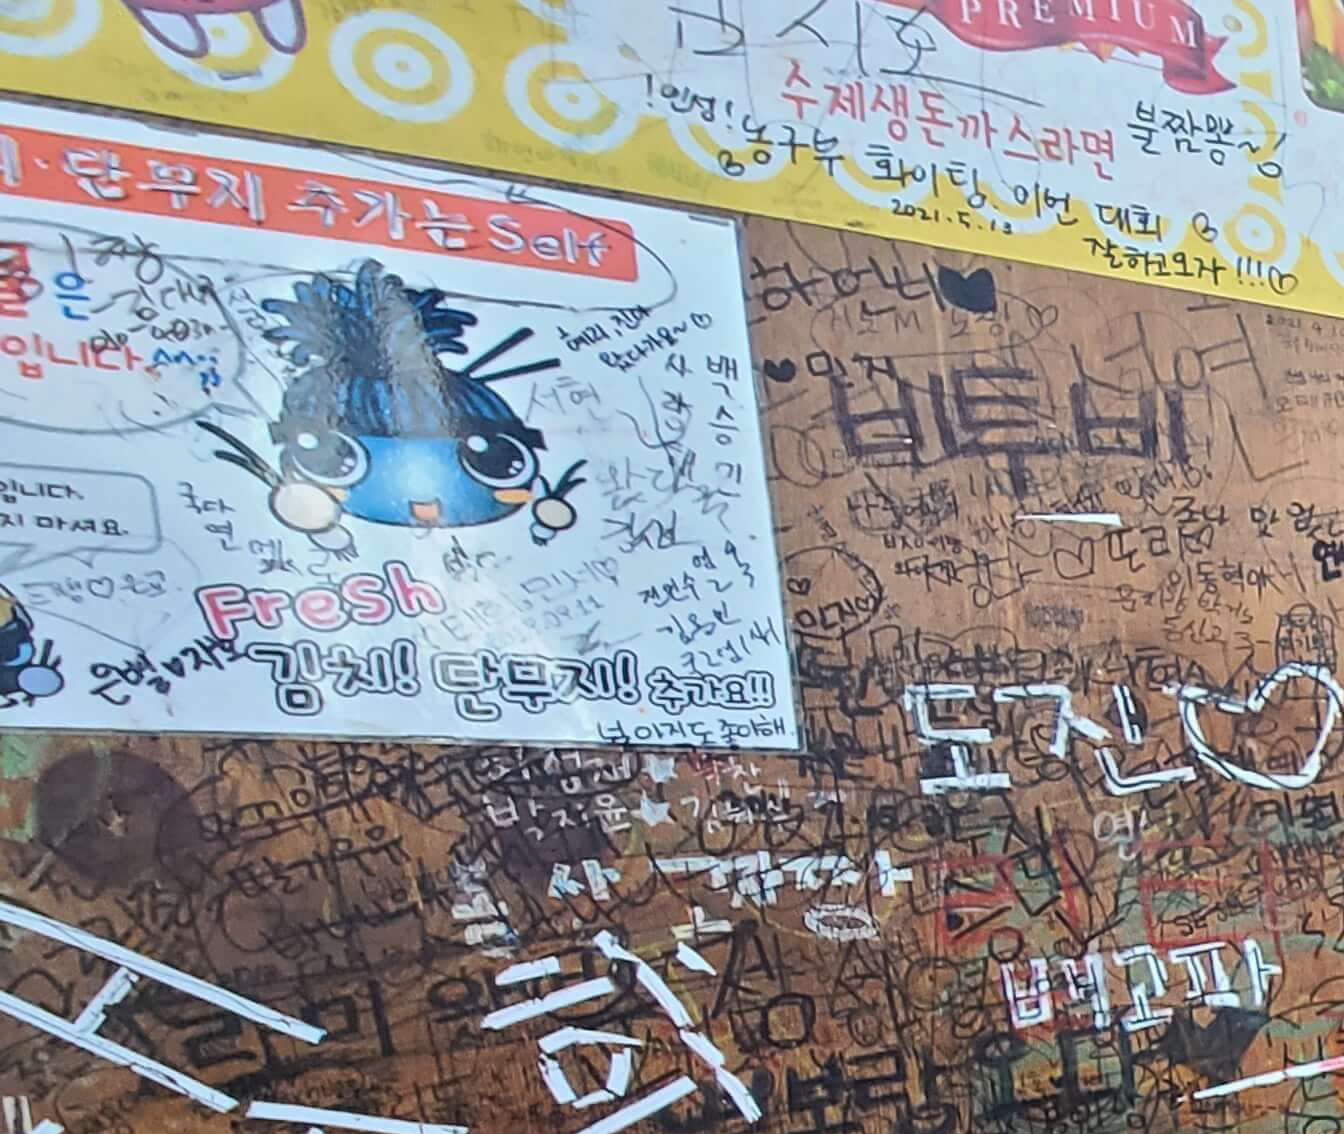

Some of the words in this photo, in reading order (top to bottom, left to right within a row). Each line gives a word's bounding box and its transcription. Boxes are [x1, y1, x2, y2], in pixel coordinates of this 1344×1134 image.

[780, 56, 1115, 182] 수제생돈까스라면
[195, 559, 448, 642] Fresh
[245, 639, 421, 716] 김치!
[431, 648, 641, 724] 단무지!
[999, 938, 1282, 1031] 배고파
